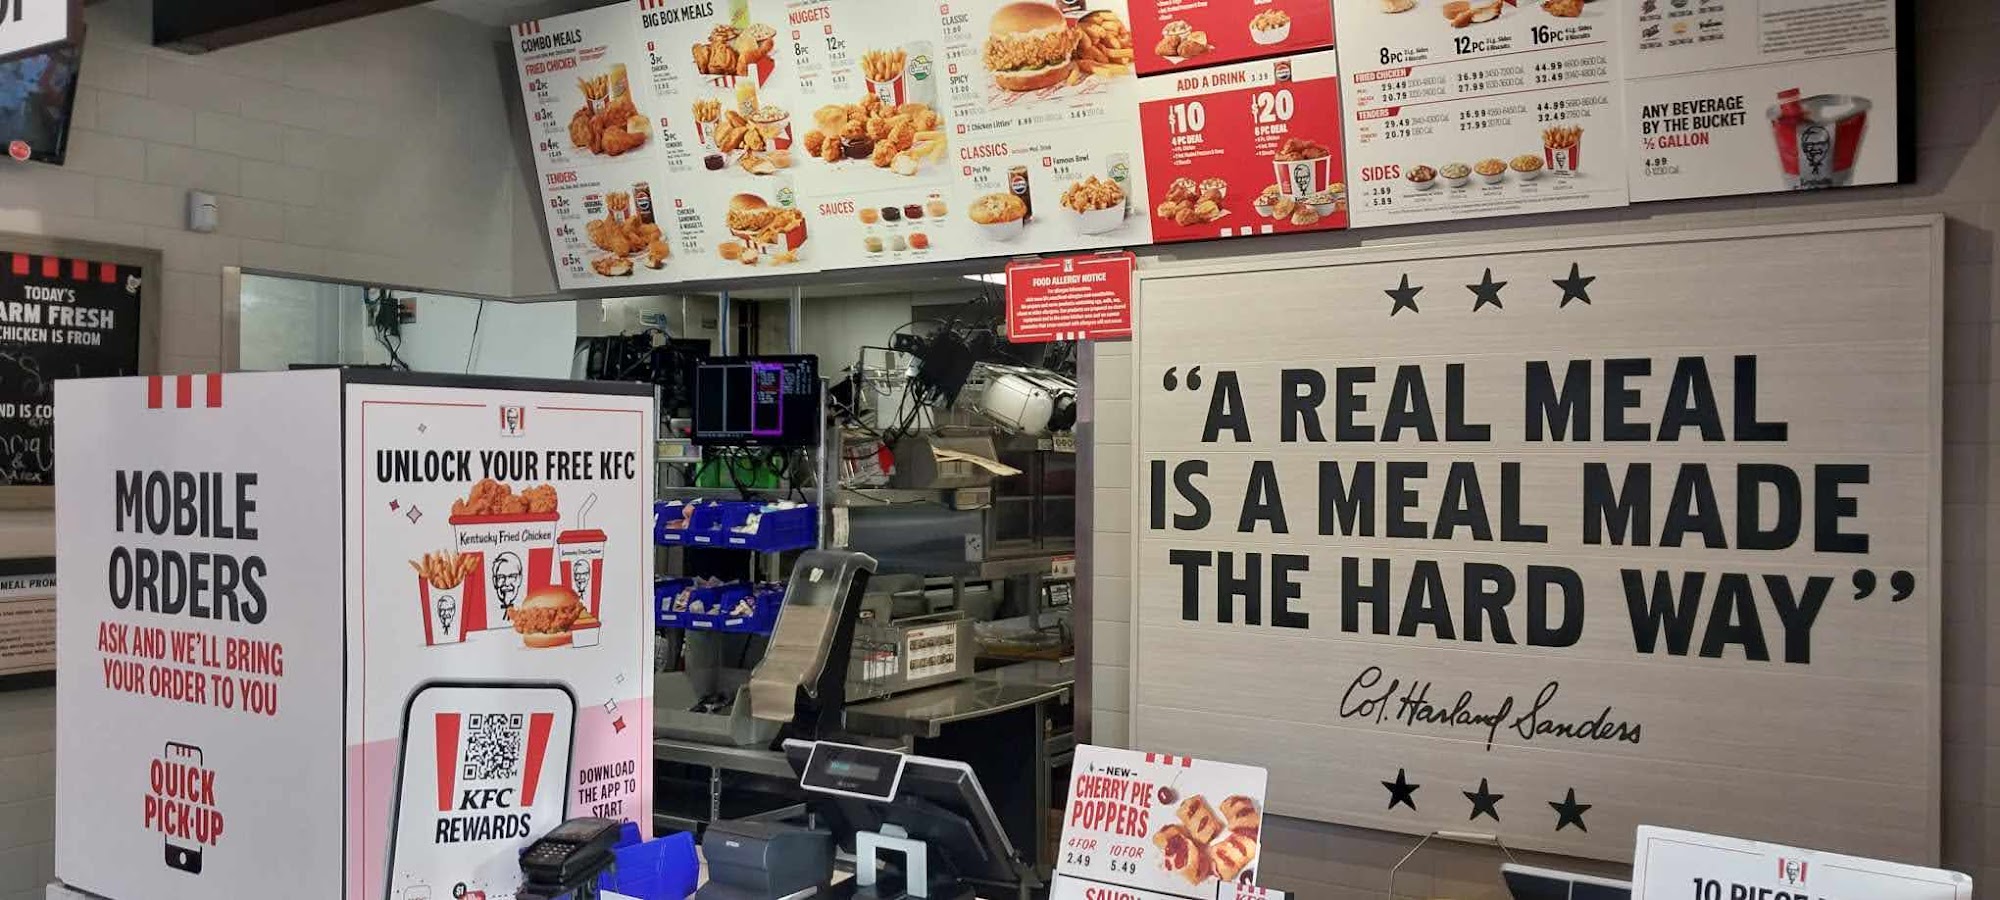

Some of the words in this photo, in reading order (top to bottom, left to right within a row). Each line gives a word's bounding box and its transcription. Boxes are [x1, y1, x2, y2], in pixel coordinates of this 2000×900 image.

[642, 12, 660, 29] BIG
[660, 7, 682, 25] BOX
[681, 2, 714, 19] MEALS
[788, 6, 831, 25] NUGGETS
[941, 13, 969, 26] CLASSIC
[521, 34, 552, 53] COMBO
[553, 29, 583, 47] MEALS
[1355, 73, 1376, 82] FRIED
[1376, 68, 1407, 81] CHICKEN
[1534, 61, 1563, 71] 44.99
[949, 74, 969, 85] SPICY
[1177, 78, 1199, 92] ADD
[1201, 77, 1210, 89] A
[1212, 71, 1246, 88] DRINK
[1535, 73, 1563, 83] 32.49
[1458, 82, 1485, 93] 27.99
[1251, 89, 1295, 124] $20
[1358, 108, 1389, 120] TENDERS
[1537, 100, 1565, 112] 44.99
[1642, 104, 1669, 119] ANY
[1673, 95, 1744, 117] BEVERAGE
[1168, 101, 1206, 134] $10
[1385, 118, 1410, 128] 29.49
[1460, 120, 1487, 131] 27.99
[1538, 111, 1566, 123] 32.49
[1642, 121, 1659, 135] BY
[1664, 118, 1690, 133] THE
[1693, 111, 1747, 131] BUCKET
[1270, 123, 1288, 134] DEAL
[1385, 129, 1411, 139] 20.79
[1187, 133, 1204, 144] DEAL
[1657, 131, 1710, 149] GALLON
[960, 143, 1008, 160] CLASSICS
[1075, 153, 1090, 163] Bowl
[1645, 157, 1668, 167] 4.99
[1361, 164, 1400, 182] SIDES
[819, 201, 855, 216] SAUCES
[1032, 276, 1051, 287] FOOD
[1051, 274, 1081, 285] ALLERGY
[1081, 272, 1107, 283] NOTICE
[24, 284, 76, 303] TODAY'S
[48, 304, 115, 330] FRESH
[52, 329, 64, 344] IS
[67, 331, 101, 346] FROM
[1162, 365, 1252, 443] “A
[1280, 363, 1492, 443] REAL
[1525, 354, 1789, 443] MEAL
[20, 403, 32, 419] IS
[376, 449, 472, 483] UNLOCK
[479, 449, 540, 483] YOUR
[545, 451, 594, 481] FREE
[599, 450, 636, 481] KFC
[115, 469, 259, 541] MOBILE
[1150, 459, 1212, 531] IS
[1237, 460, 1290, 534] A
[1318, 460, 1548, 544] MEAL
[1583, 461, 1870, 554] MADE
[459, 531, 498, 547] Kentucky
[499, 530, 521, 544] Fried
[521, 529, 552, 543] Chicken
[108, 545, 268, 625] ORDERS
[1169, 548, 1310, 630] THE
[1340, 556, 1586, 648] HARD
[1619, 567, 1916, 665] WAY”
[98, 621, 128, 655] ASK
[132, 625, 166, 660] AND
[170, 629, 221, 668] WE'LL
[226, 637, 284, 678] BRING
[103, 657, 145, 695] YOUR
[150, 666, 206, 705] ORDER
[211, 674, 235, 709] TO
[239, 677, 278, 717] YOU
[1339, 666, 1400, 724] Col.
[1396, 680, 1514, 752] Harland
[1508, 680, 1642, 744] Sanders
[579, 759, 636, 786] DOWNLOAD
[150, 758, 216, 807] QUICK
[578, 787, 598, 805] THE
[600, 782, 623, 801] APP
[623, 777, 636, 795] TO
[1075, 774, 1130, 802] CHERRY
[1131, 780, 1154, 809] PIE
[459, 787, 514, 811] KFC
[591, 799, 624, 818] START
[144, 793, 225, 847] PICK-UP
[1071, 799, 1150, 839] POPPERS
[435, 813, 532, 845] REWARDS
[1067, 838, 1076, 847] 4
[1075, 839, 1098, 850] FOR
[1109, 844, 1122, 856] 10
[1122, 845, 1145, 859] FOR
[1066, 852, 1091, 867] 2.49
[1110, 859, 1137, 875] 5.49
